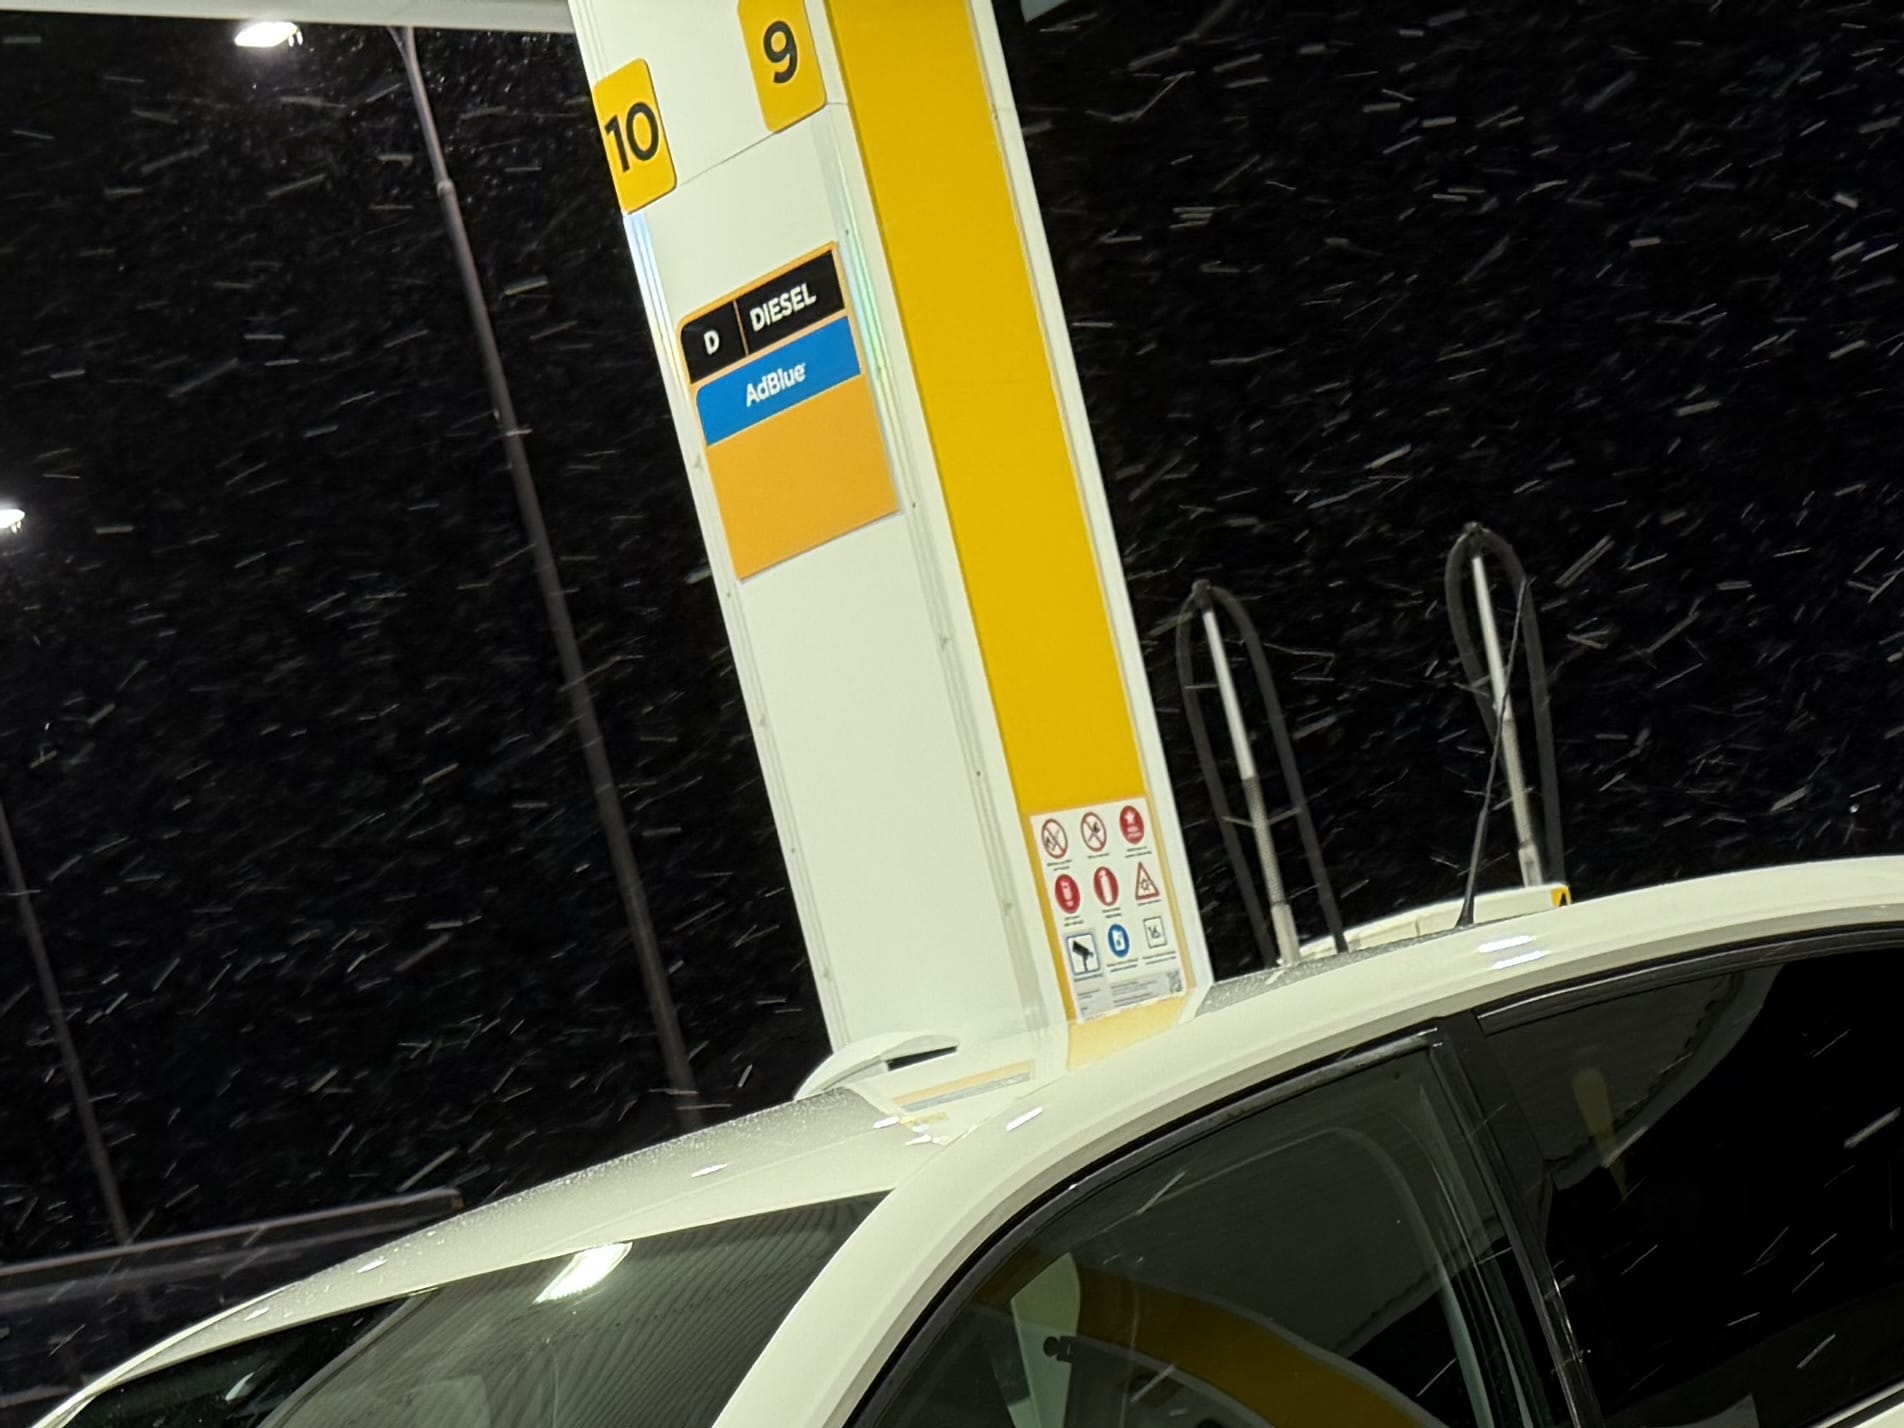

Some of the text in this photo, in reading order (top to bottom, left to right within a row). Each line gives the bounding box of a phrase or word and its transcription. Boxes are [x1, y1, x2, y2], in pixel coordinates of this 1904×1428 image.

[762, 20, 797, 84] 9
[604, 101, 659, 173] 10
[703, 283, 816, 355] D DIESEL
[746, 361, 806, 407] AdBlue
